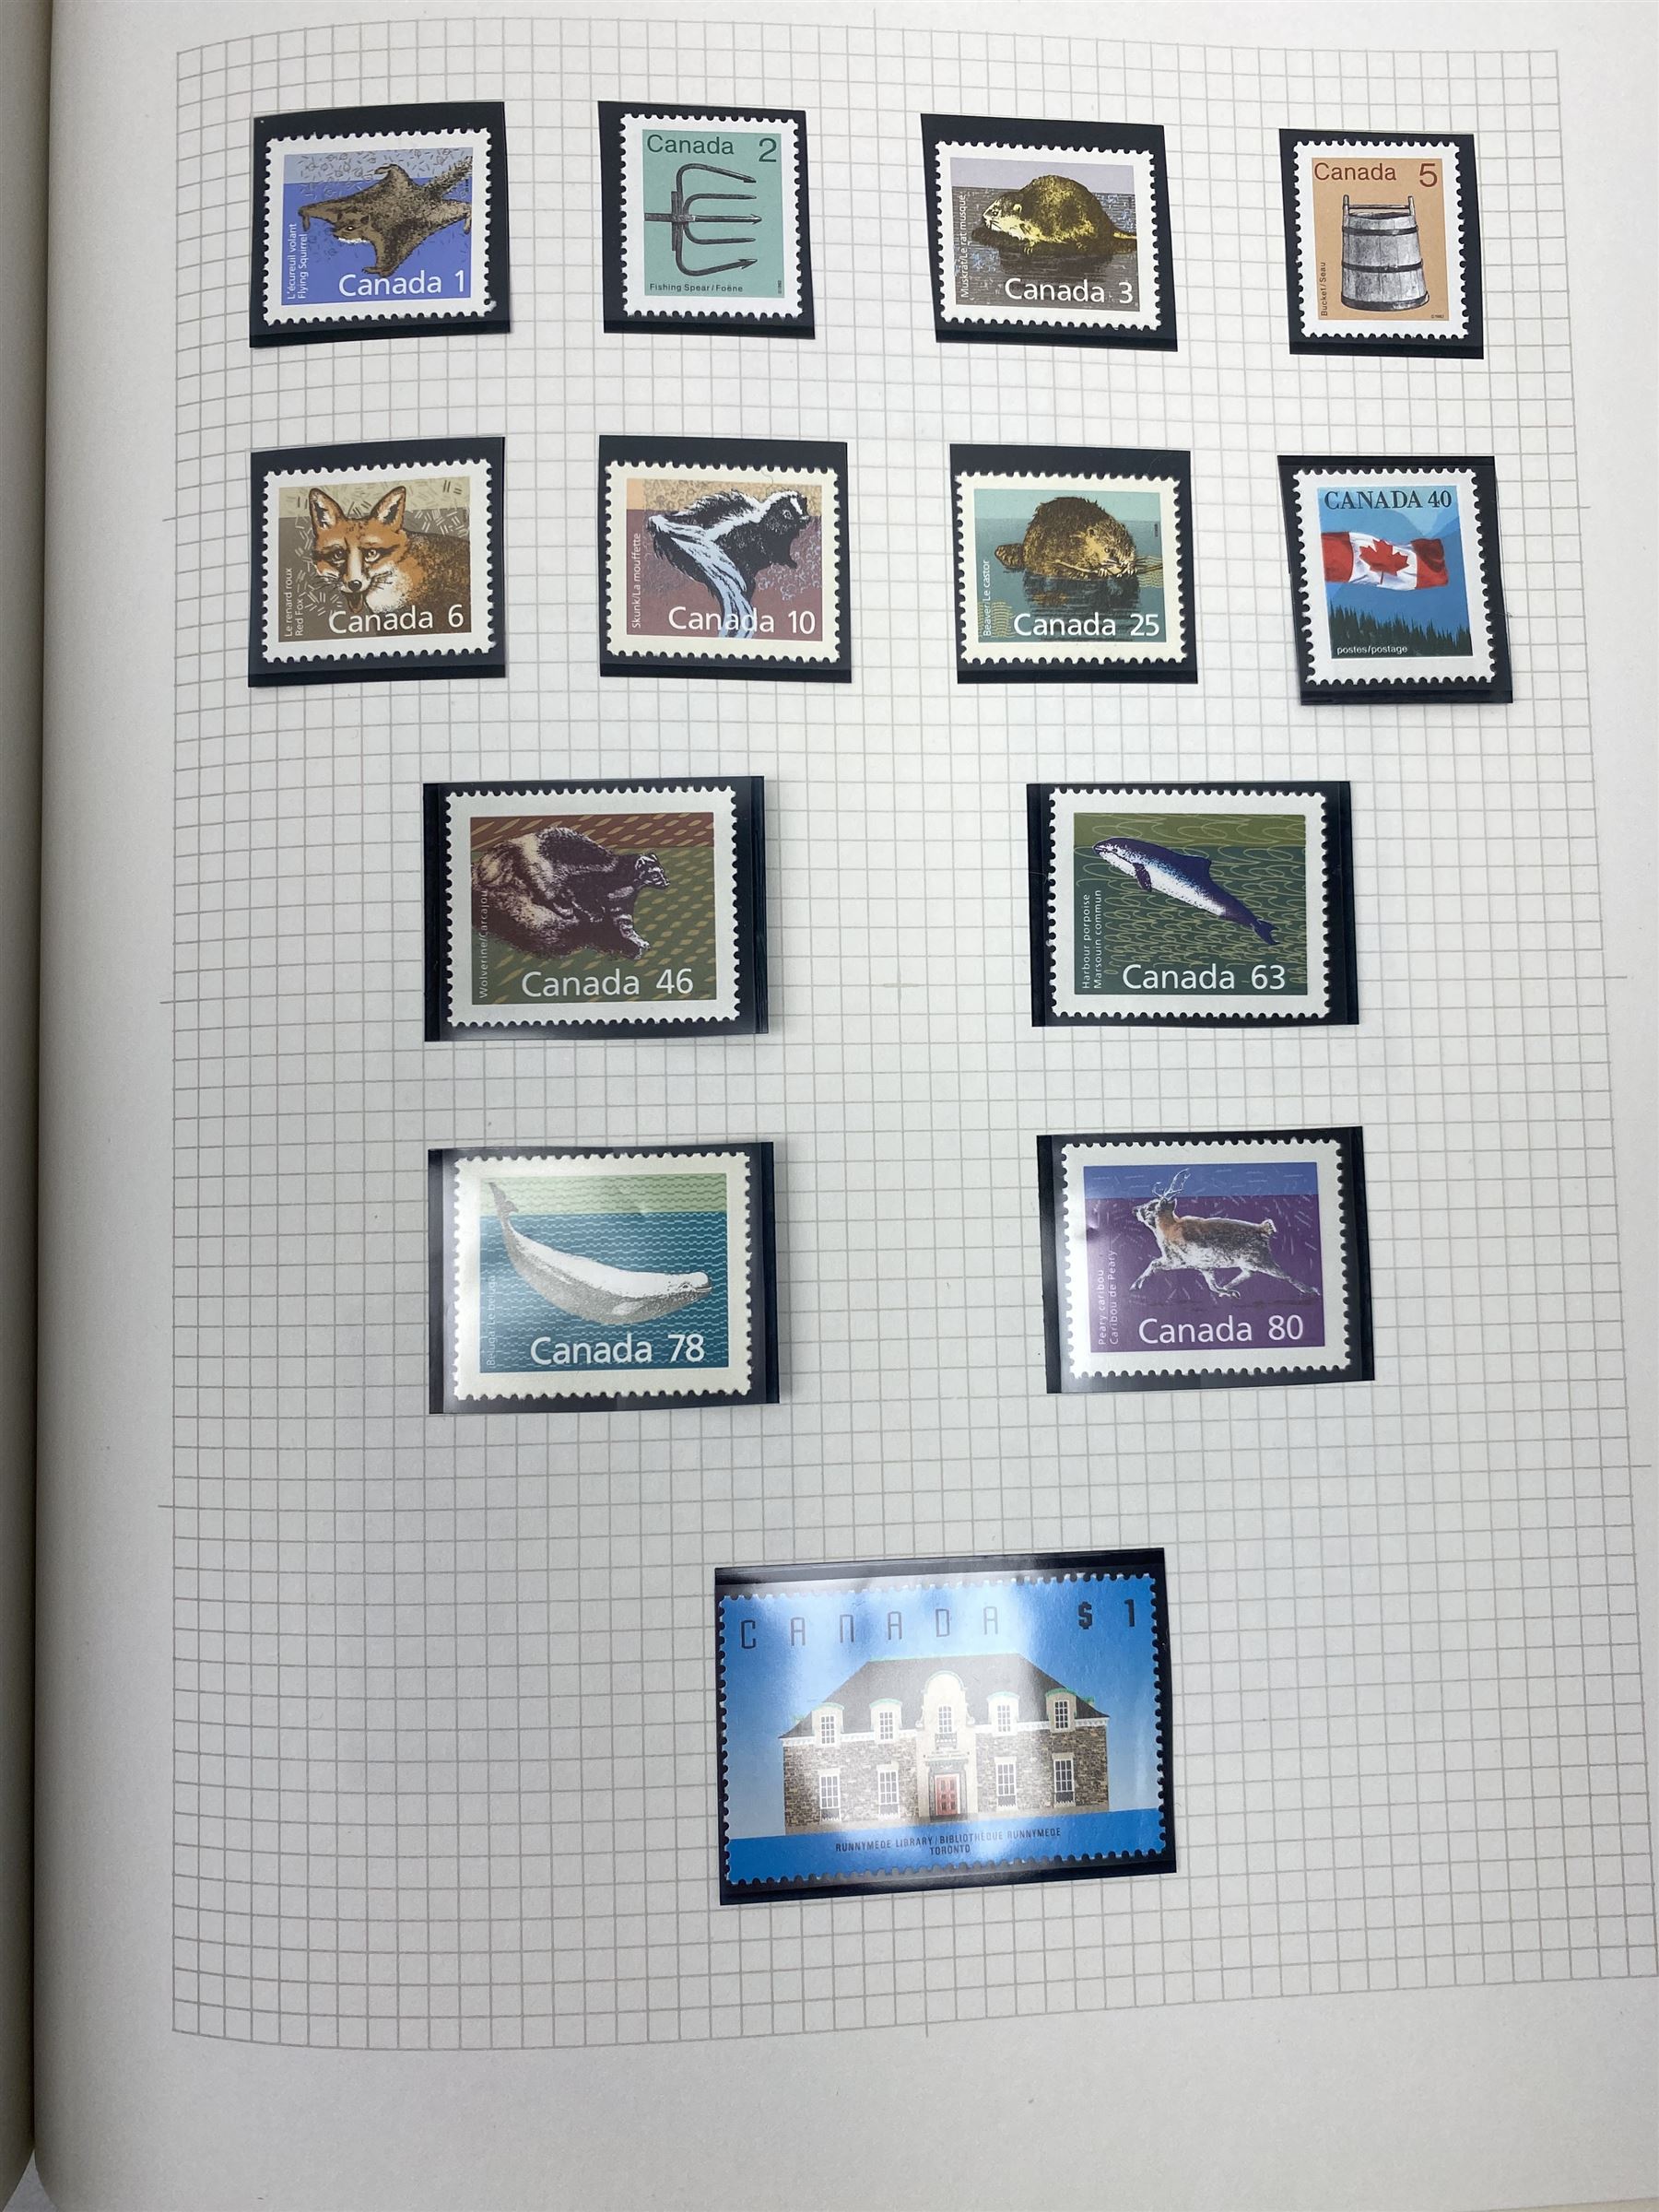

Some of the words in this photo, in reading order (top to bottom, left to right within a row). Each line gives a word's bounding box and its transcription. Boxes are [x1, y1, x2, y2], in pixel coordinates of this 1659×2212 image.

[647, 135, 735, 155] Canada
[759, 137, 777, 162] 2
[1314, 162, 1396, 181] Canada
[1419, 163, 1438, 187] 5
[959, 194, 968, 229] musque
[288, 223, 297, 253] volant
[298, 233, 309, 269] Squirrel
[287, 254, 296, 300] L'écureuil
[297, 271, 309, 299] Flying
[338, 270, 442, 297] Canada
[454, 270, 465, 293] 1
[959, 247, 970, 298] Muskrat/Le
[650, 283, 682, 292] Fishing
[1005, 277, 1105, 303] Canada
[1118, 282, 1134, 304] 3
[1319, 262, 1328, 316] Bucket/Seau
[1324, 490, 1423, 510] CANADA
[1428, 490, 1452, 508] 40
[631, 533, 641, 582] mouffette
[982, 559, 991, 588] castor
[283, 592, 292, 623] renard
[295, 598, 303, 615] Fox
[329, 606, 433, 633] Canada
[448, 605, 465, 628] 6
[631, 584, 641, 629] Skunk/La
[668, 606, 775, 633] Canada
[788, 610, 816, 634] 10
[284, 625, 293, 637] Le
[295, 618, 304, 636] Red
[1014, 612, 1116, 636] Canada
[1130, 613, 1159, 636] 25
[1336, 645, 1408, 655] postes/postage
[1083, 894, 1092, 941] porpoise
[479, 890, 490, 999] Wolverine/Carcajou
[1081, 945, 1090, 989] Harbour
[1093, 939, 1102, 989] Marsouin
[1122, 964, 1235, 990] Canada
[1251, 964, 1287, 990] 63
[522, 968, 641, 997] Canada
[655, 968, 694, 994] 46
[1108, 1250, 1117, 1280] Peary
[1097, 1269, 1106, 1311] caribou
[1108, 1284, 1117, 1298] de
[1098, 1315, 1107, 1345] Peary
[1110, 1301, 1119, 1345] Caribou
[1138, 1315, 1253, 1344] Canada
[1268, 1314, 1303, 1340] 80
[530, 1334, 653, 1365] Canada
[667, 1334, 705, 1362] 78
[835, 1841, 891, 1853] RUNNYMEDE
[1007, 1827, 1061, 1840] RUNNYMEDE
[930, 1844, 971, 1855] TORONTO
